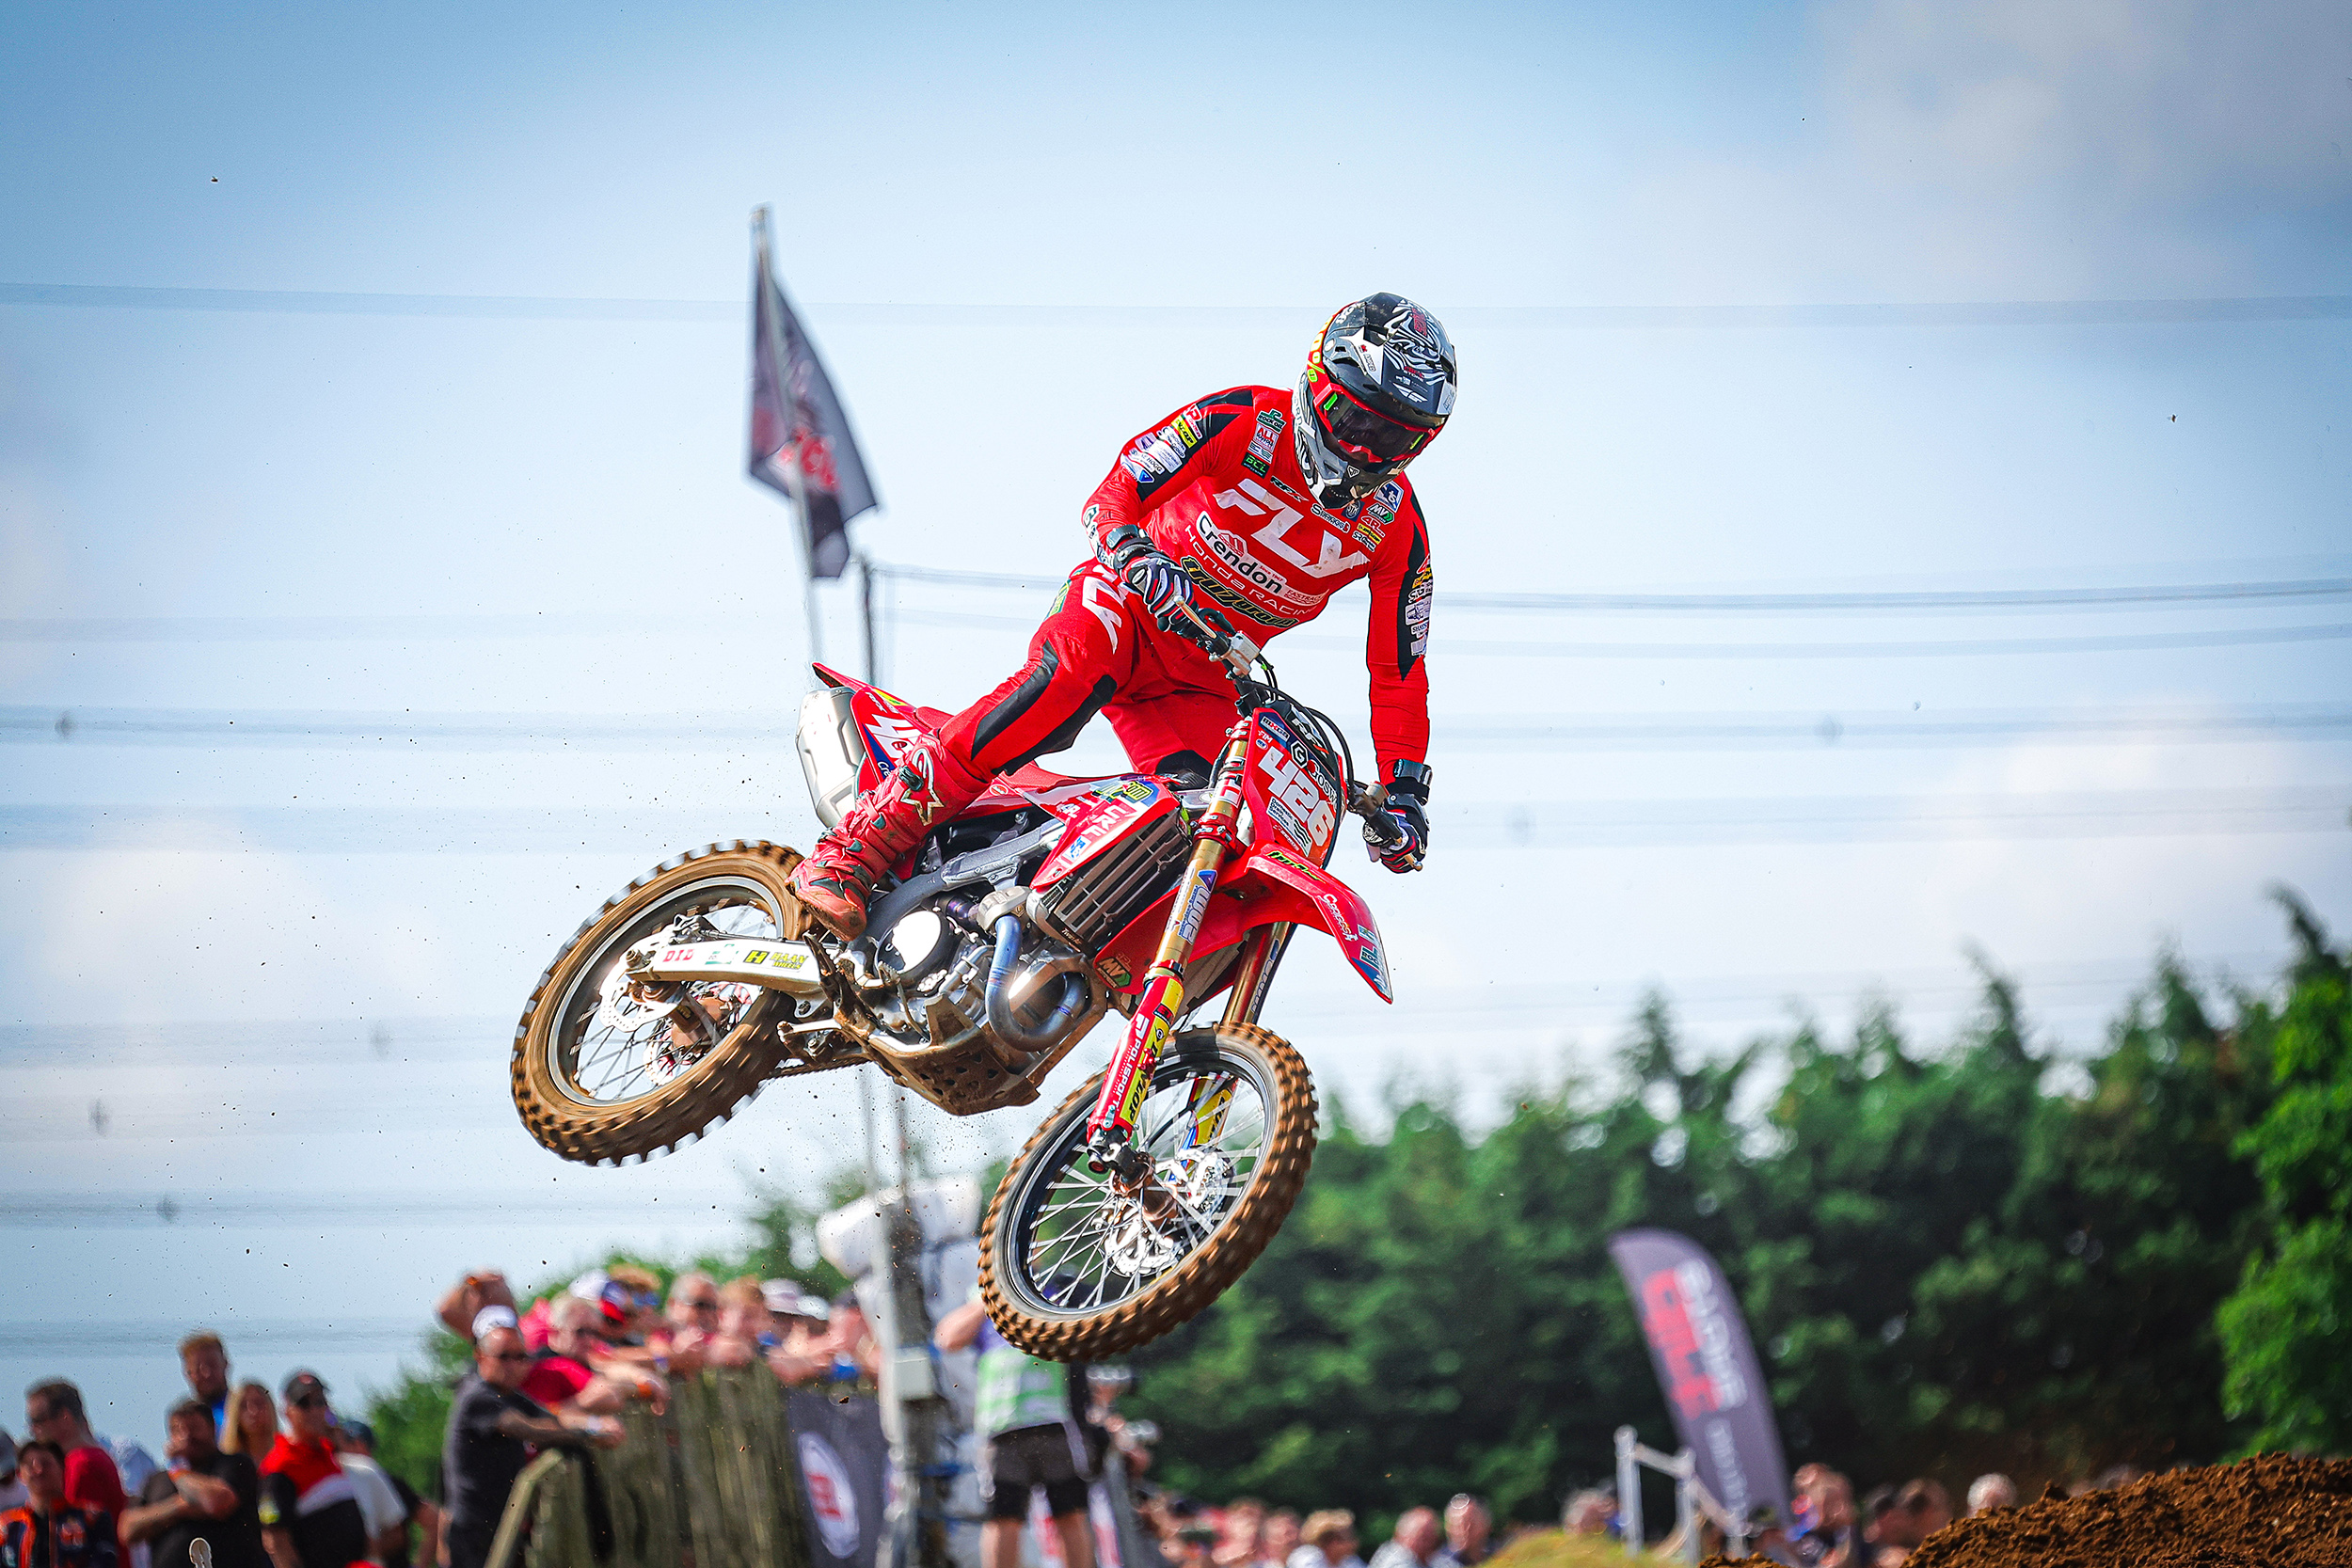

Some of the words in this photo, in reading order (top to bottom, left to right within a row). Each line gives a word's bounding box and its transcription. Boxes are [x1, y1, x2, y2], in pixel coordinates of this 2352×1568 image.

[1212, 478, 1370, 578] FLY
[1199, 515, 1283, 594] Crendon
[1259, 564, 1272, 576] Since
[1258, 746, 1335, 847] 426
[662, 949, 695, 962] DID
[770, 952, 809, 964] HAAN
[771, 960, 803, 970] WHEELS
[1113, 1037, 1144, 1113] POLISPORT
